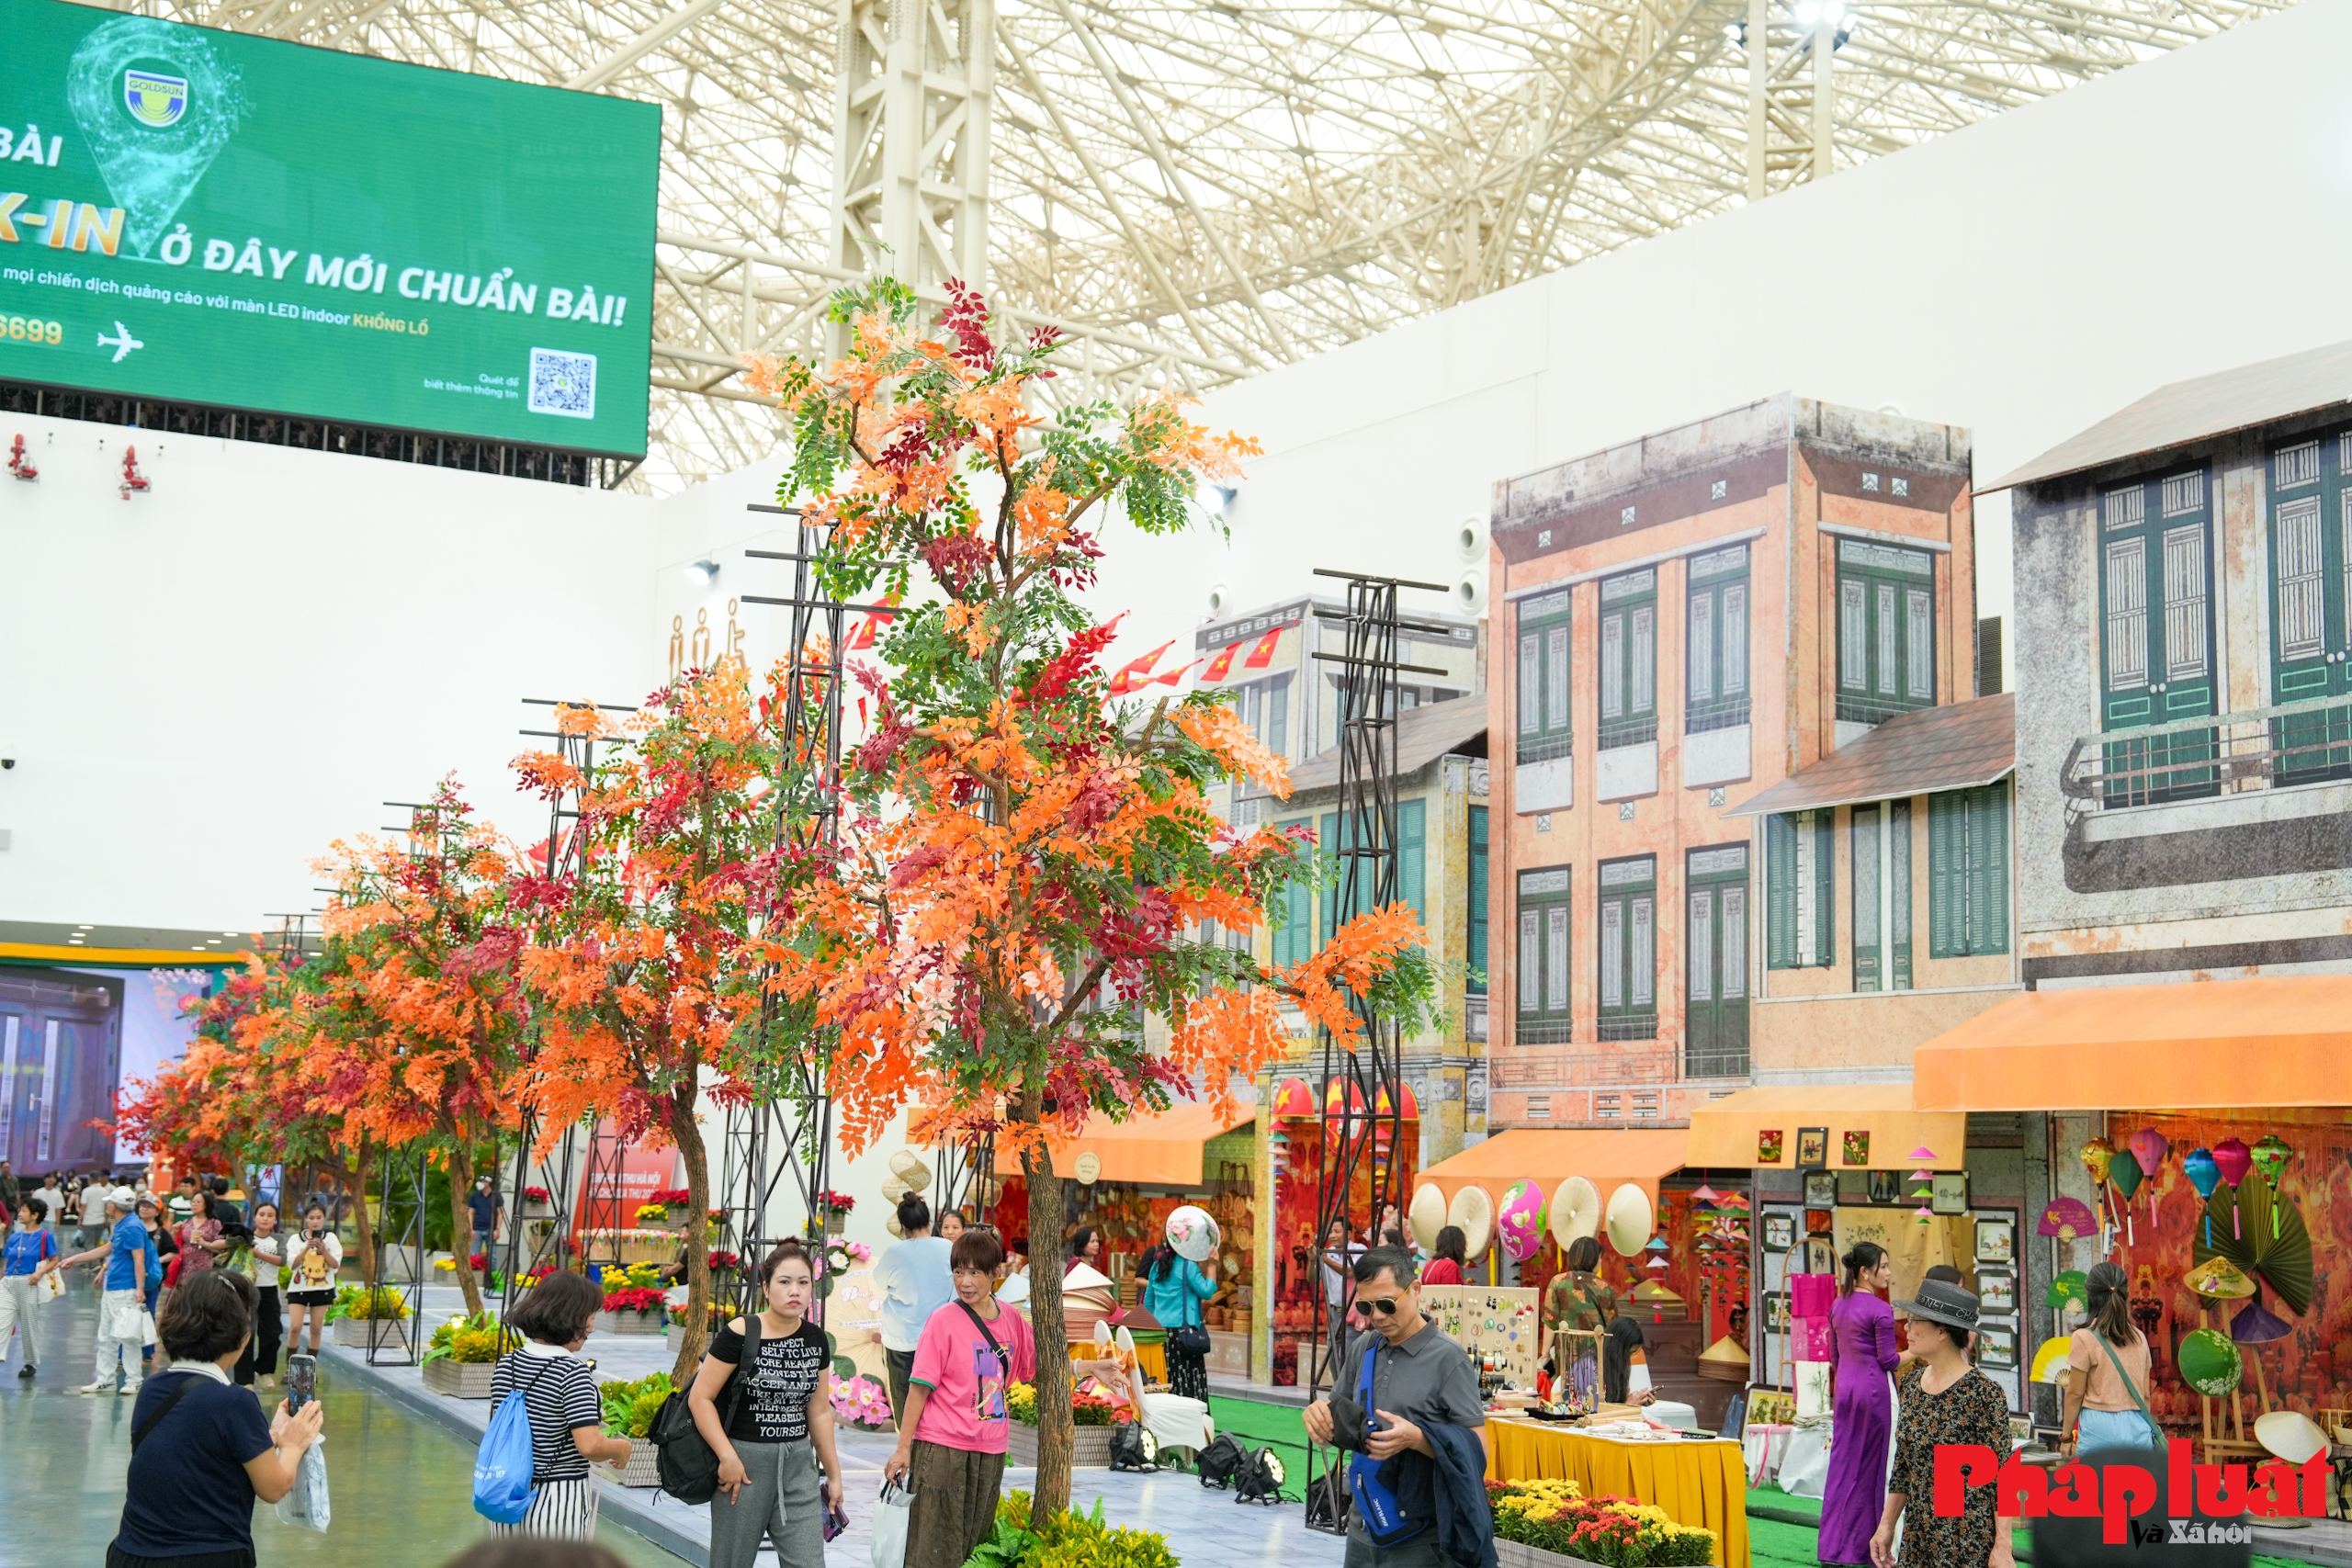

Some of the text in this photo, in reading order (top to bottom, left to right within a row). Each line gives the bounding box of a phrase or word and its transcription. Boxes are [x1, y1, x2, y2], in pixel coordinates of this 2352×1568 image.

[129, 80, 184, 96] GOLDSUN
[161, 223, 627, 327] Ở ĐÂY MỚI CHUẨN BÀI!
[4, 267, 34, 284] mọi
[38, 271, 82, 288] chiến
[85, 277, 119, 294] dịch
[122, 284, 171, 304] quảng
[174, 290, 203, 306] cáo
[232, 299, 265, 314] màn
[268, 302, 299, 319] LED
[301, 307, 351, 325] indoor
[473, 385, 503, 399] thông
[504, 389, 519, 399] tin
[761, 1346, 786, 1359] SELF
[788, 1382, 810, 1391] AND
[760, 1425, 806, 1438] YOURSELF
